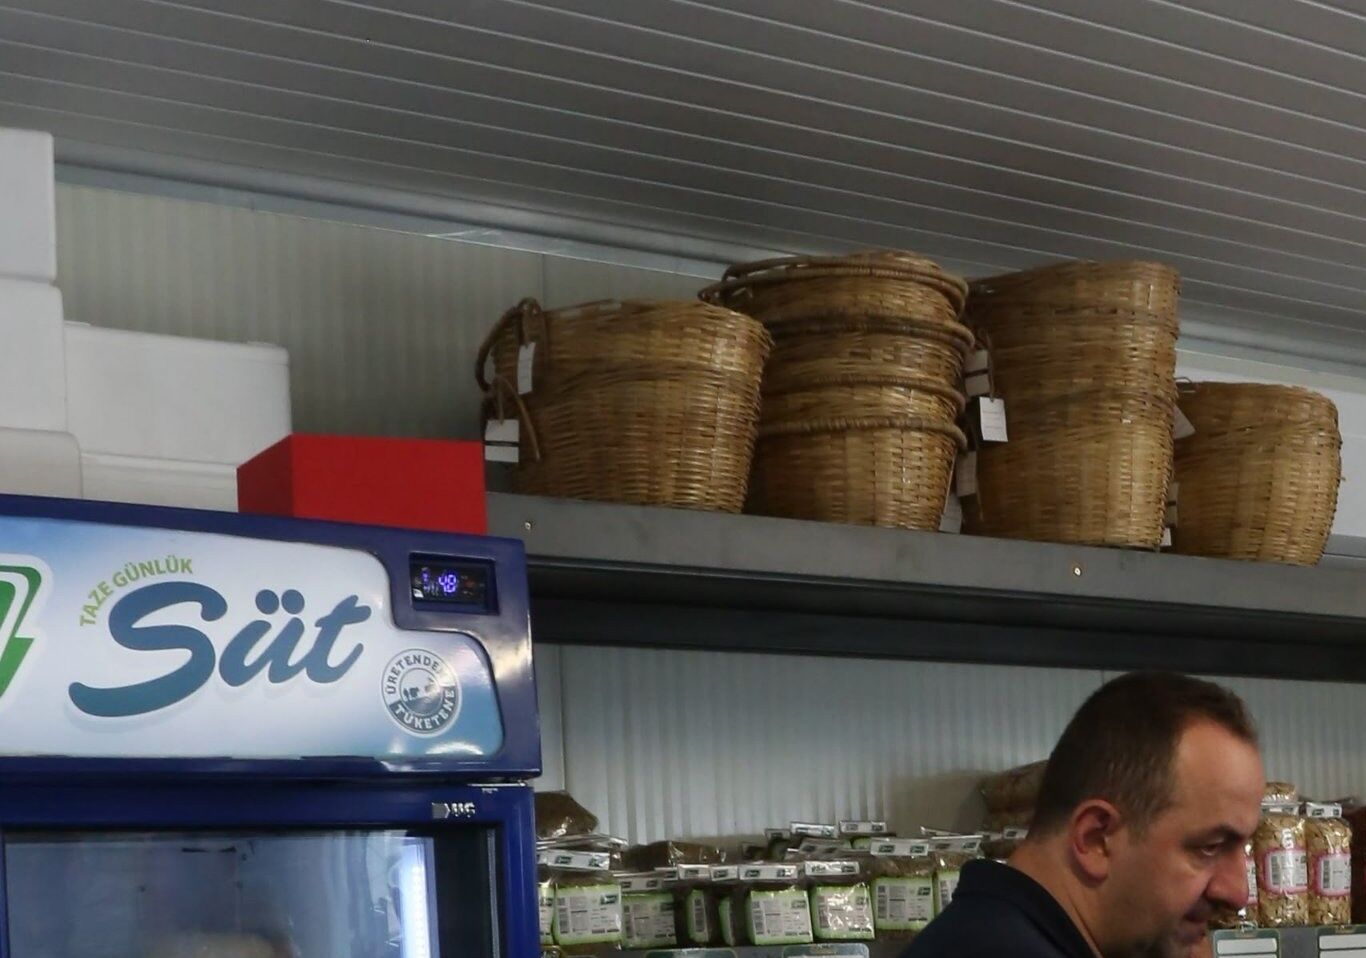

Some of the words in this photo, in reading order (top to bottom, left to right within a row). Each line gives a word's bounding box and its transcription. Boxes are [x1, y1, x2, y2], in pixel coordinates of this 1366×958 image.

[80, 581, 114, 627] TAZE
[112, 555, 193, 587] GÜNLÜK
[68, 581, 372, 718] Süt
[385, 654, 443, 695] ÜRETENDE
